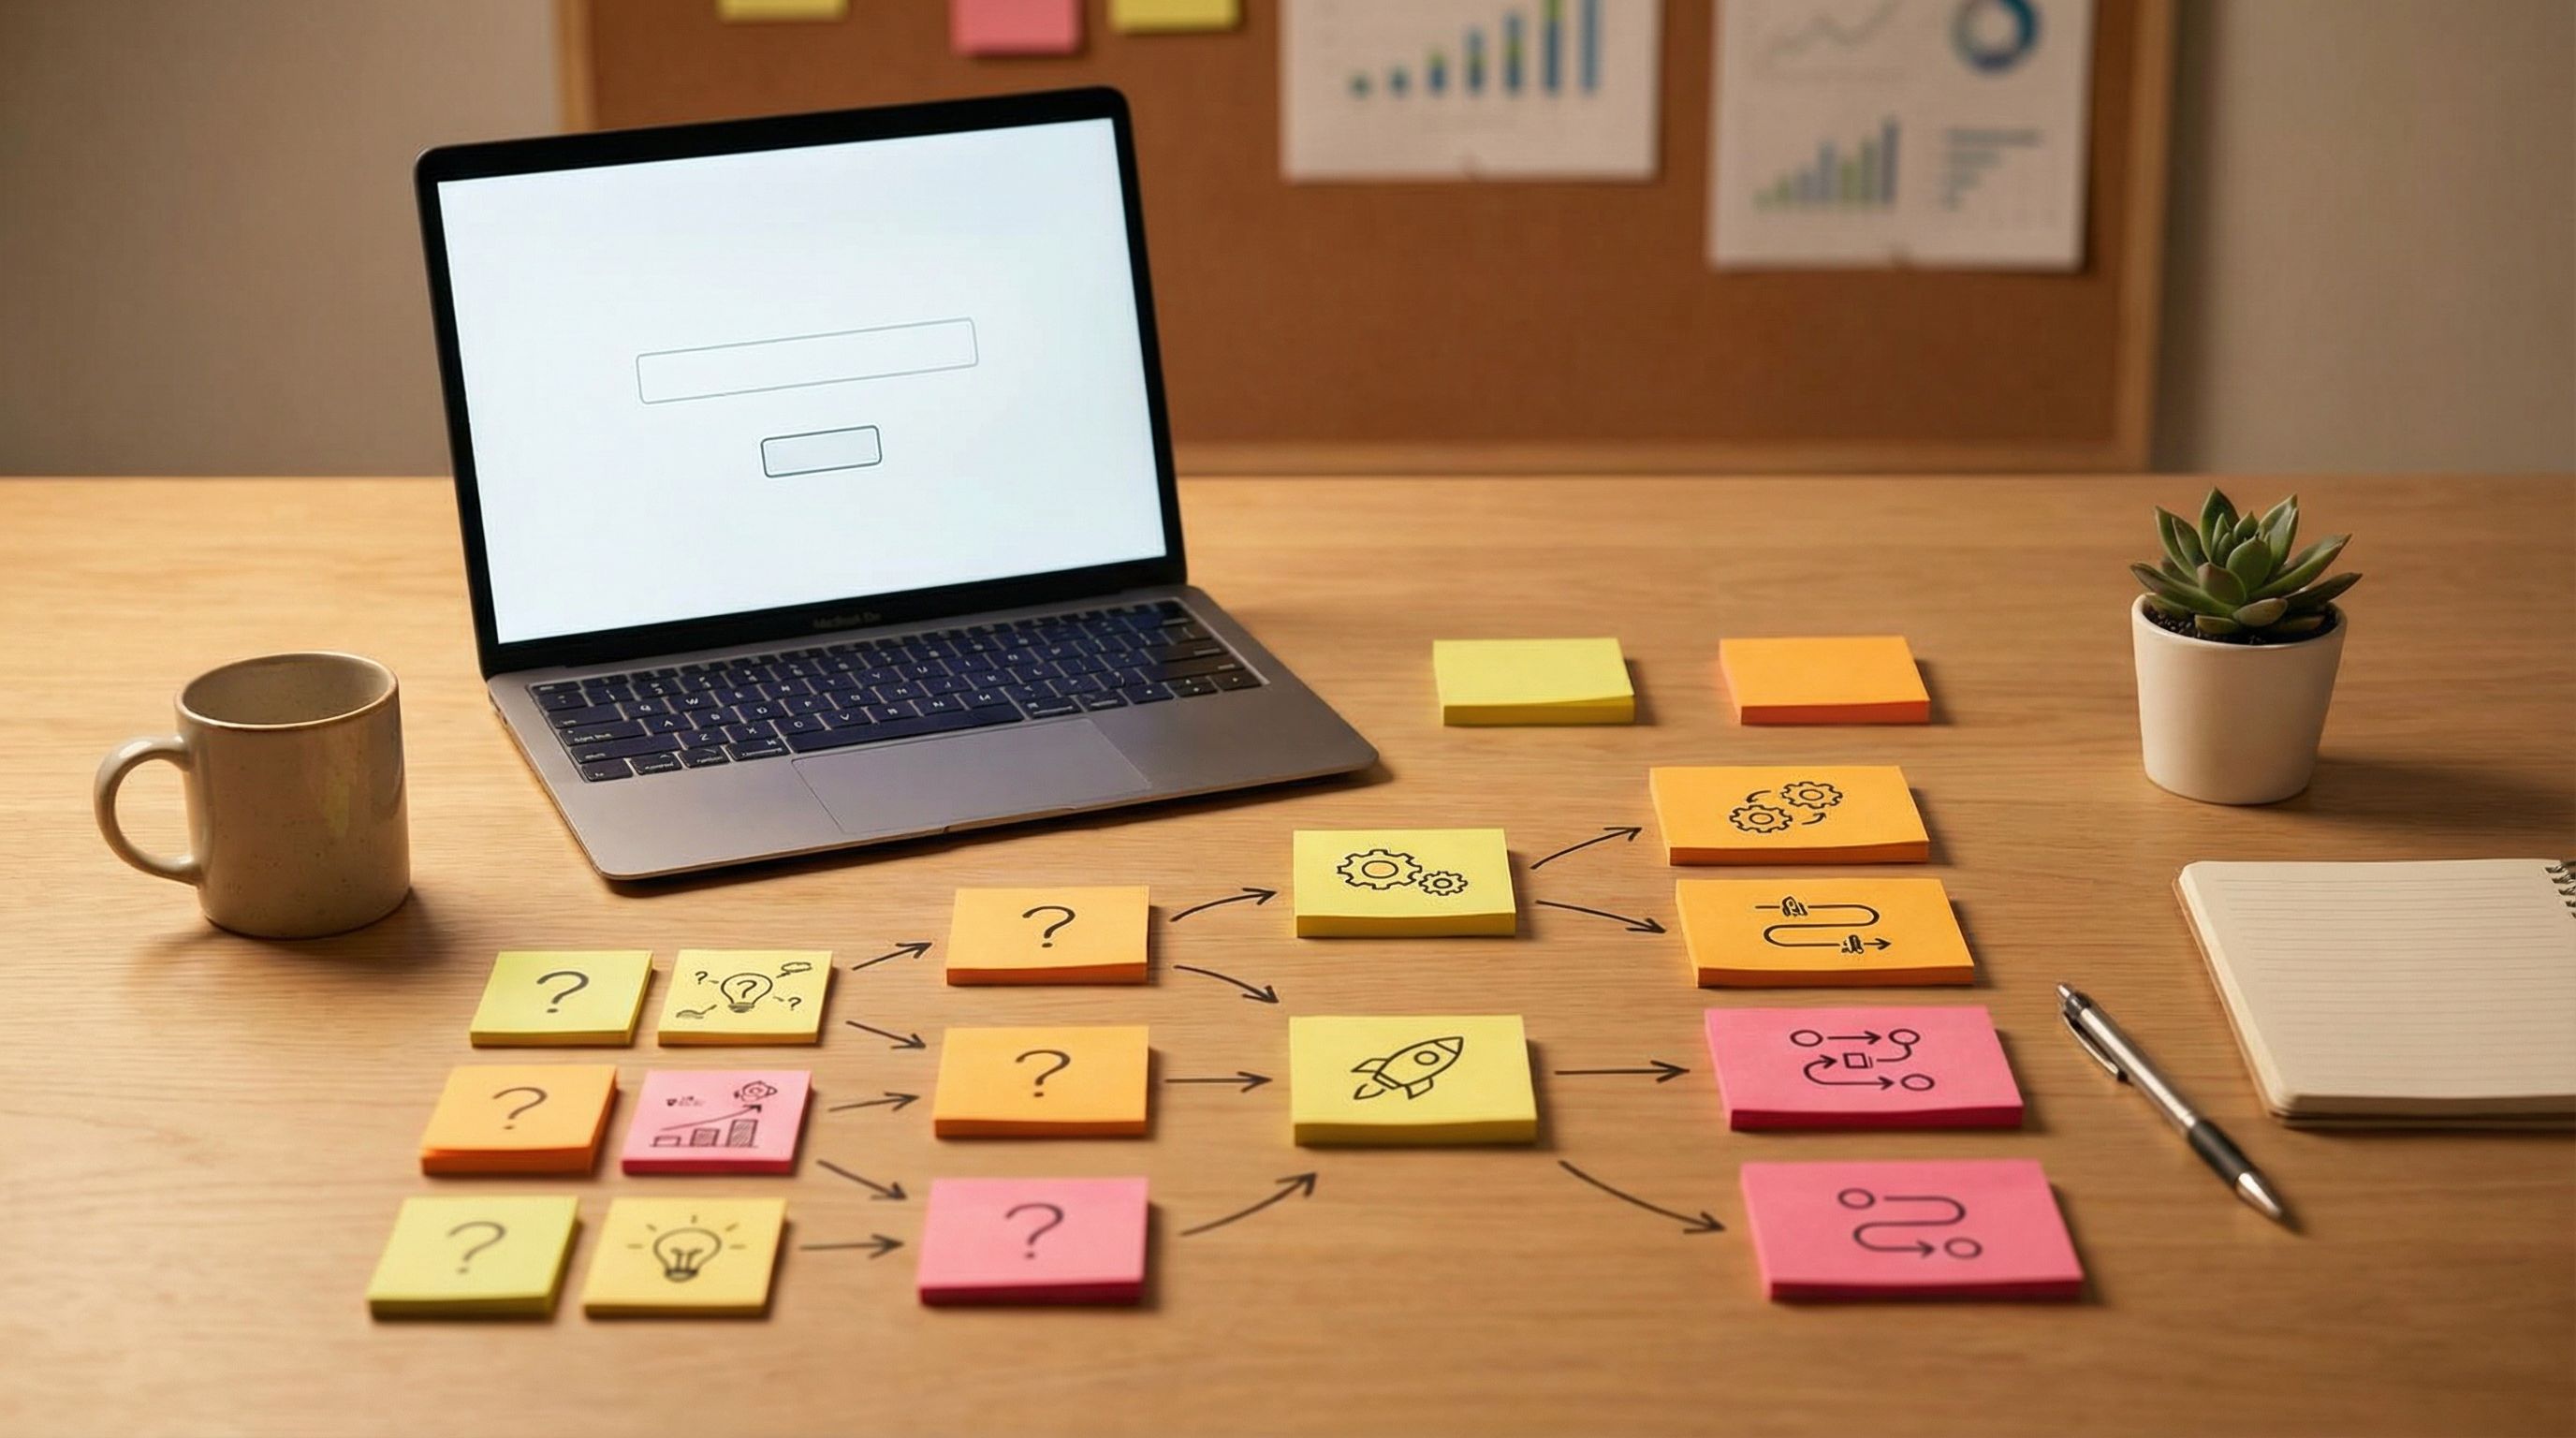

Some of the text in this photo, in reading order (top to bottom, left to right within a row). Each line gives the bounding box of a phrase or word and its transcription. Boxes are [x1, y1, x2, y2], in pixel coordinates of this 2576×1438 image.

[1022, 905, 1076, 947] ?
[536, 971, 589, 1014] ?
[695, 971, 709, 985] ?
[788, 997, 802, 1011] ?
[1016, 1049, 1070, 1098] ?
[492, 1086, 548, 1131] ?
[447, 1221, 506, 1274] ?
[1005, 1202, 1064, 1259] ?
